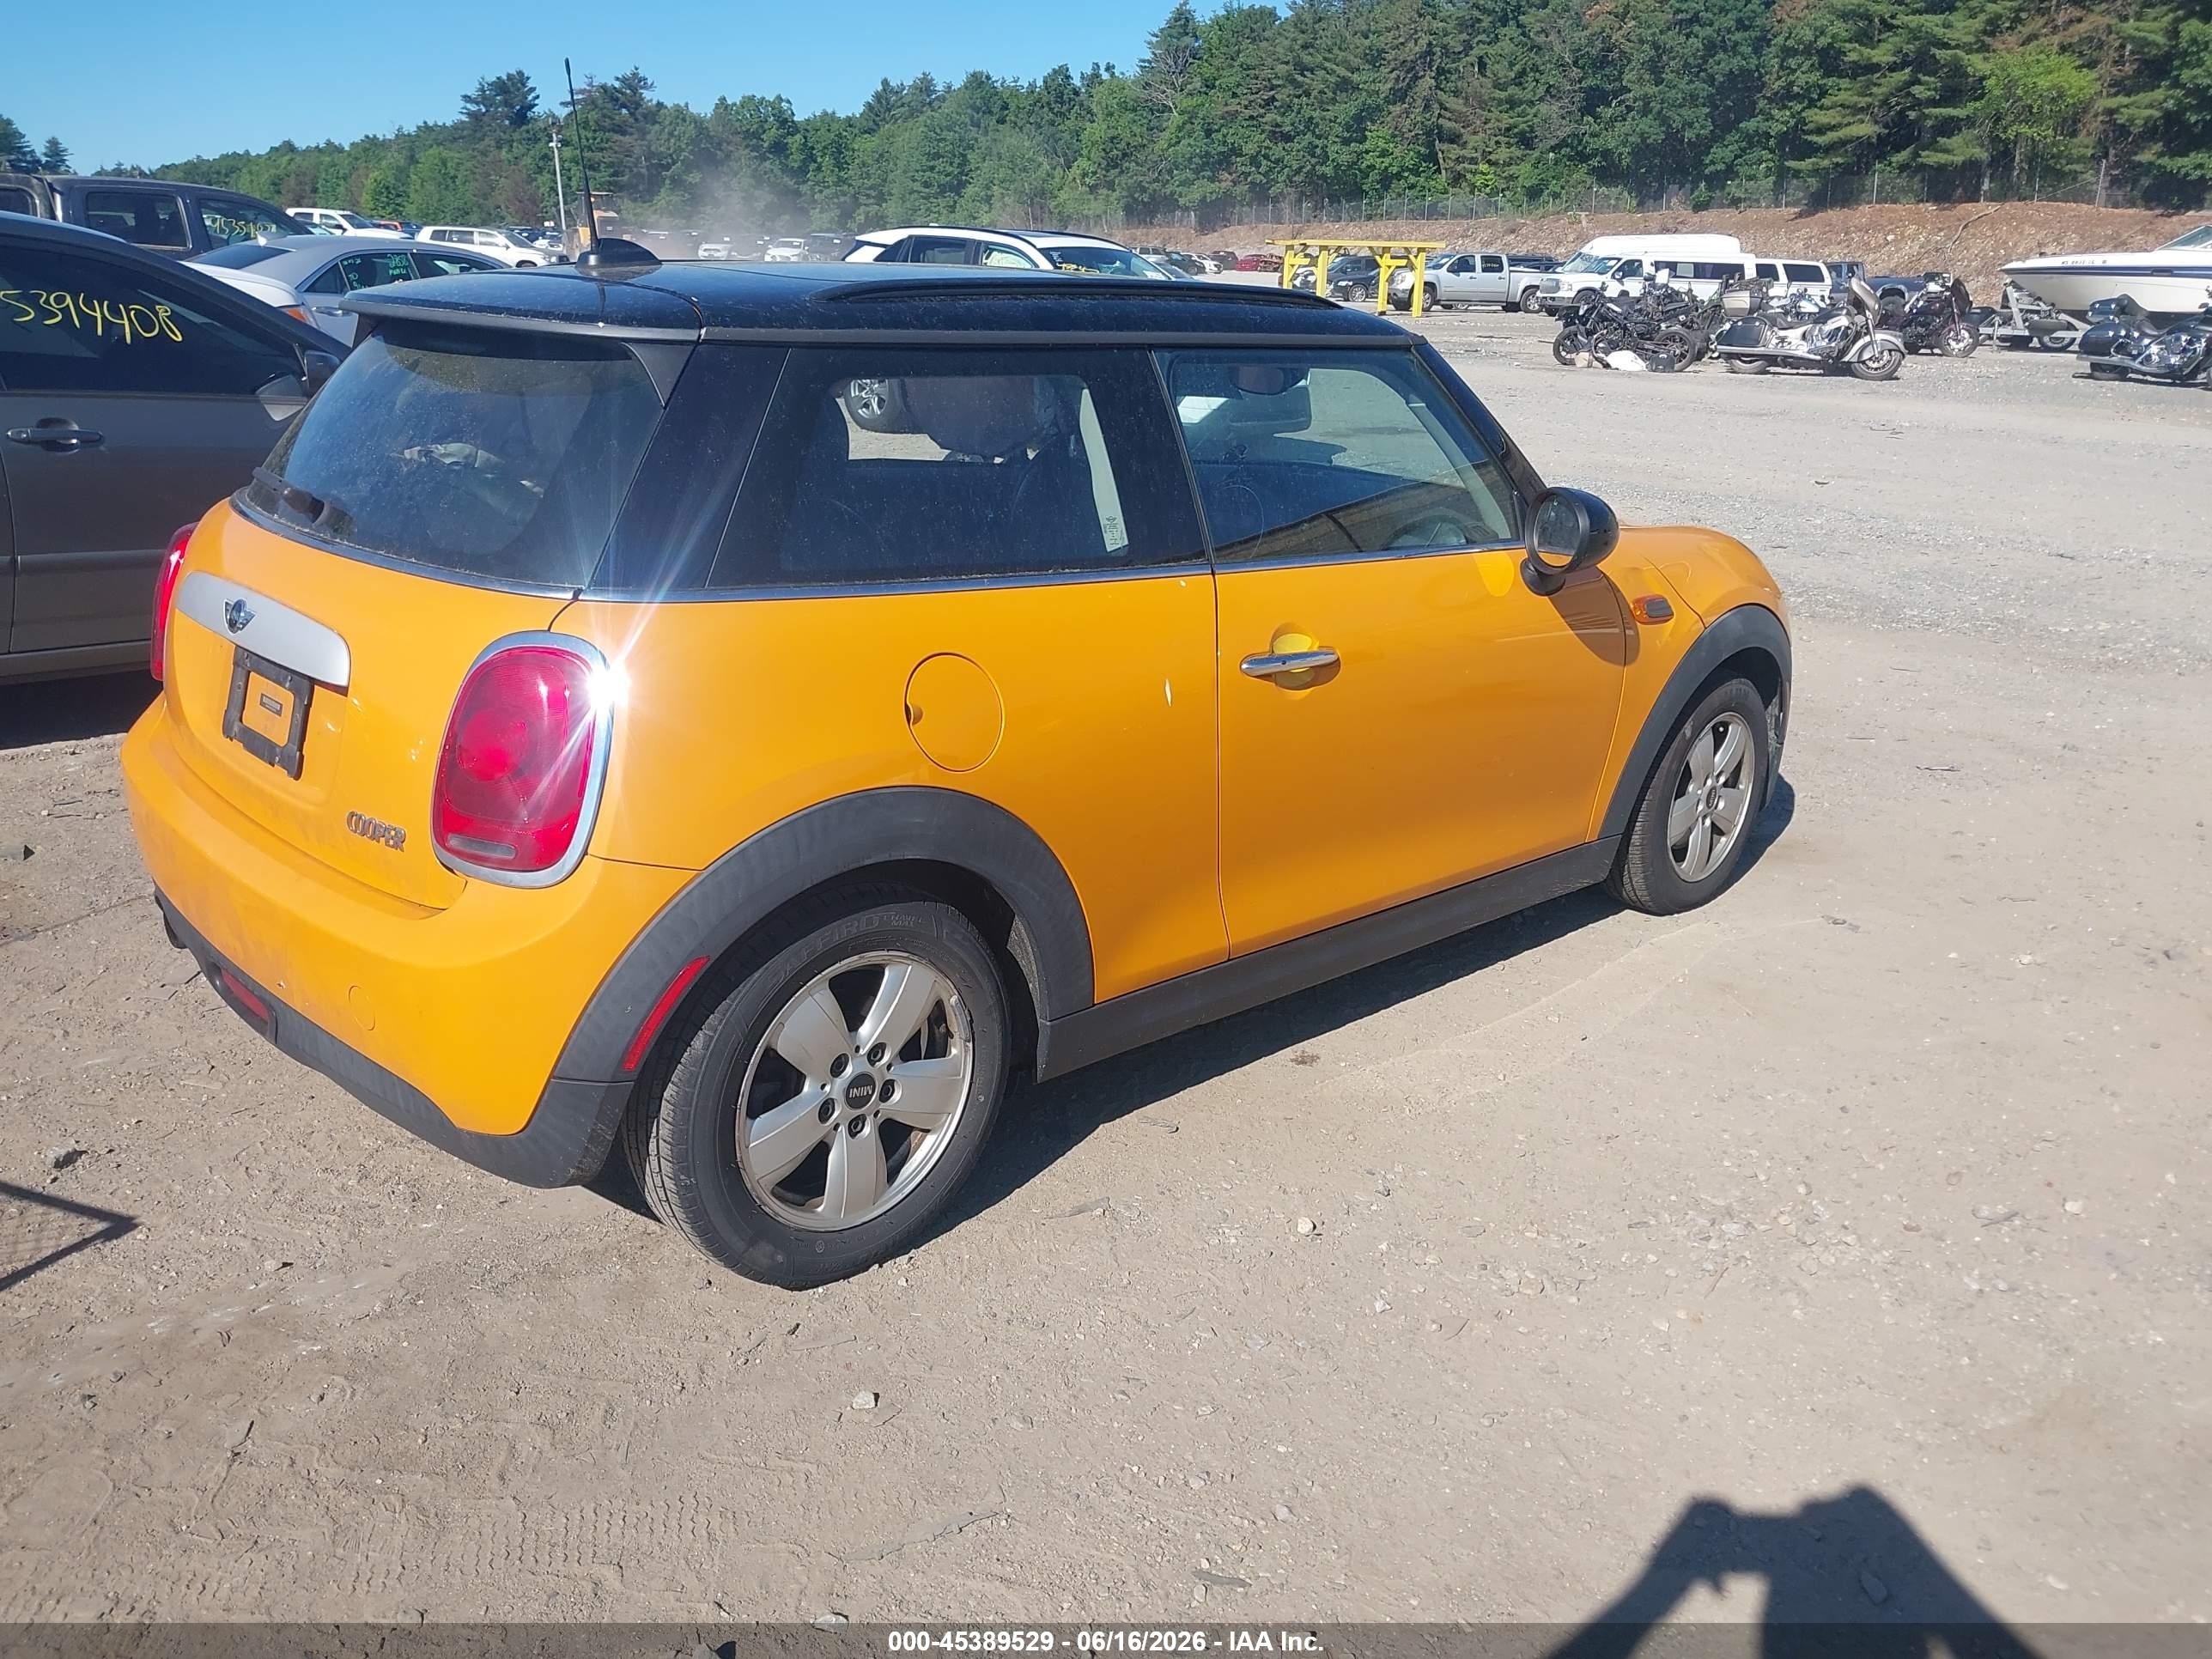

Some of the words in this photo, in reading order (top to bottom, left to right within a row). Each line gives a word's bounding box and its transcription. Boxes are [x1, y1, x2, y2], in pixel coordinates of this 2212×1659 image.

[0, 290, 183, 344] 5394408
[347, 811, 406, 852] COOPER
[849, 1085, 872, 1098] MINI
